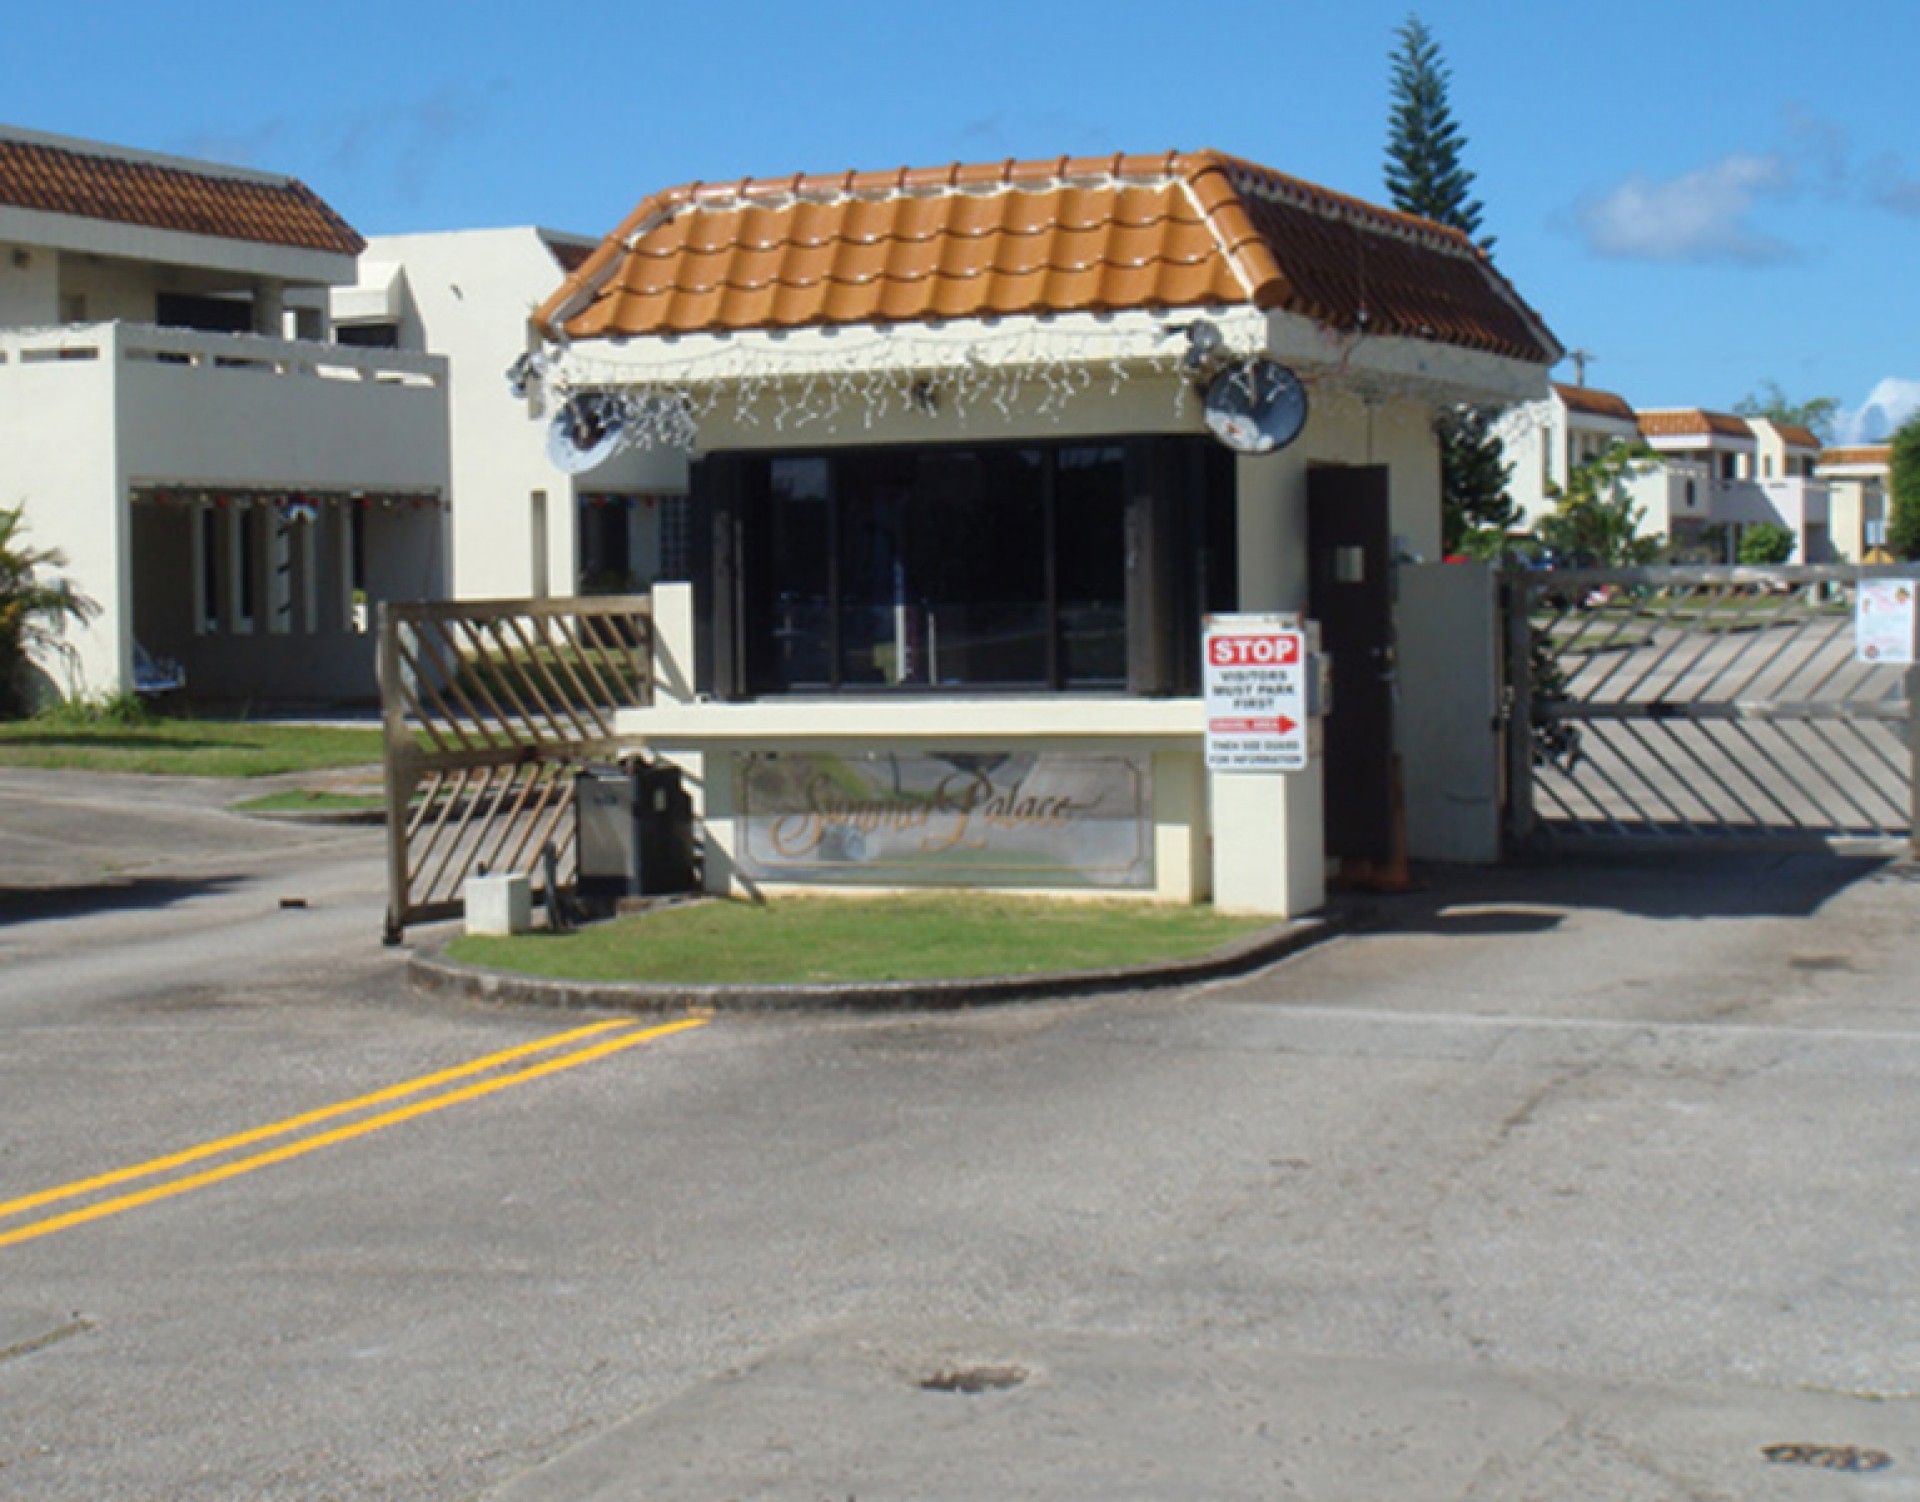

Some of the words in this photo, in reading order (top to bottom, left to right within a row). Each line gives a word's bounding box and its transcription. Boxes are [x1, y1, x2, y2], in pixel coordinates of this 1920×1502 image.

[1215, 639, 1293, 662] STOP
[1220, 670, 1287, 682] VISITORS
[1212, 685, 1253, 697] MUST
[1257, 684, 1295, 696] PARK
[1232, 698, 1275, 710] FIRST
[769, 773, 936, 857] Summer
[920, 767, 1104, 850] Palace
